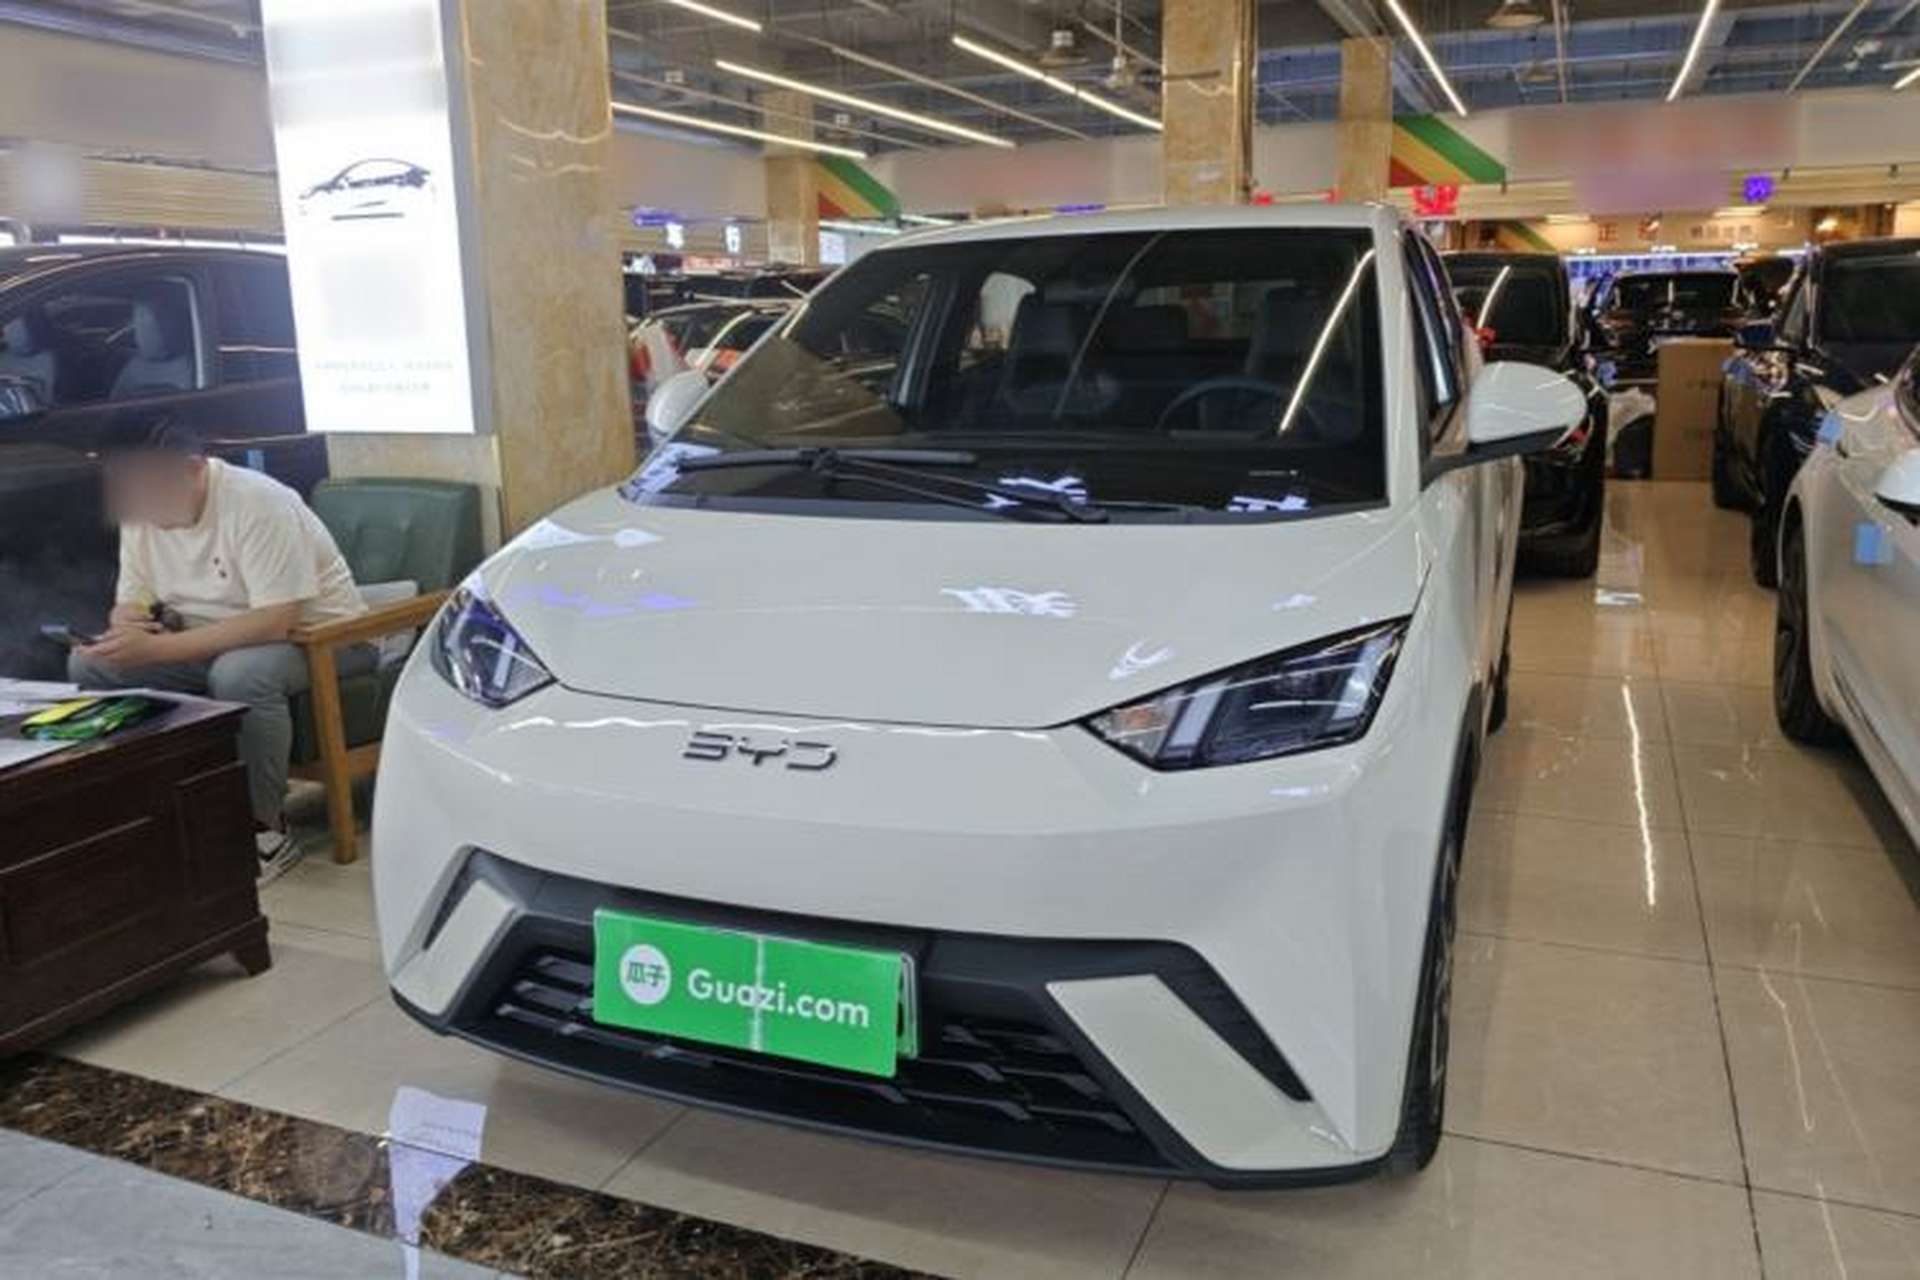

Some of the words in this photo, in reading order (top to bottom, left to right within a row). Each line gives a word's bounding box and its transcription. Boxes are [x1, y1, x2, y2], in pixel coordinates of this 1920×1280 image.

[683, 731, 837, 771] BYD
[626, 961, 666, 988] 瓜子
[687, 968, 870, 1028] Guazi.com
